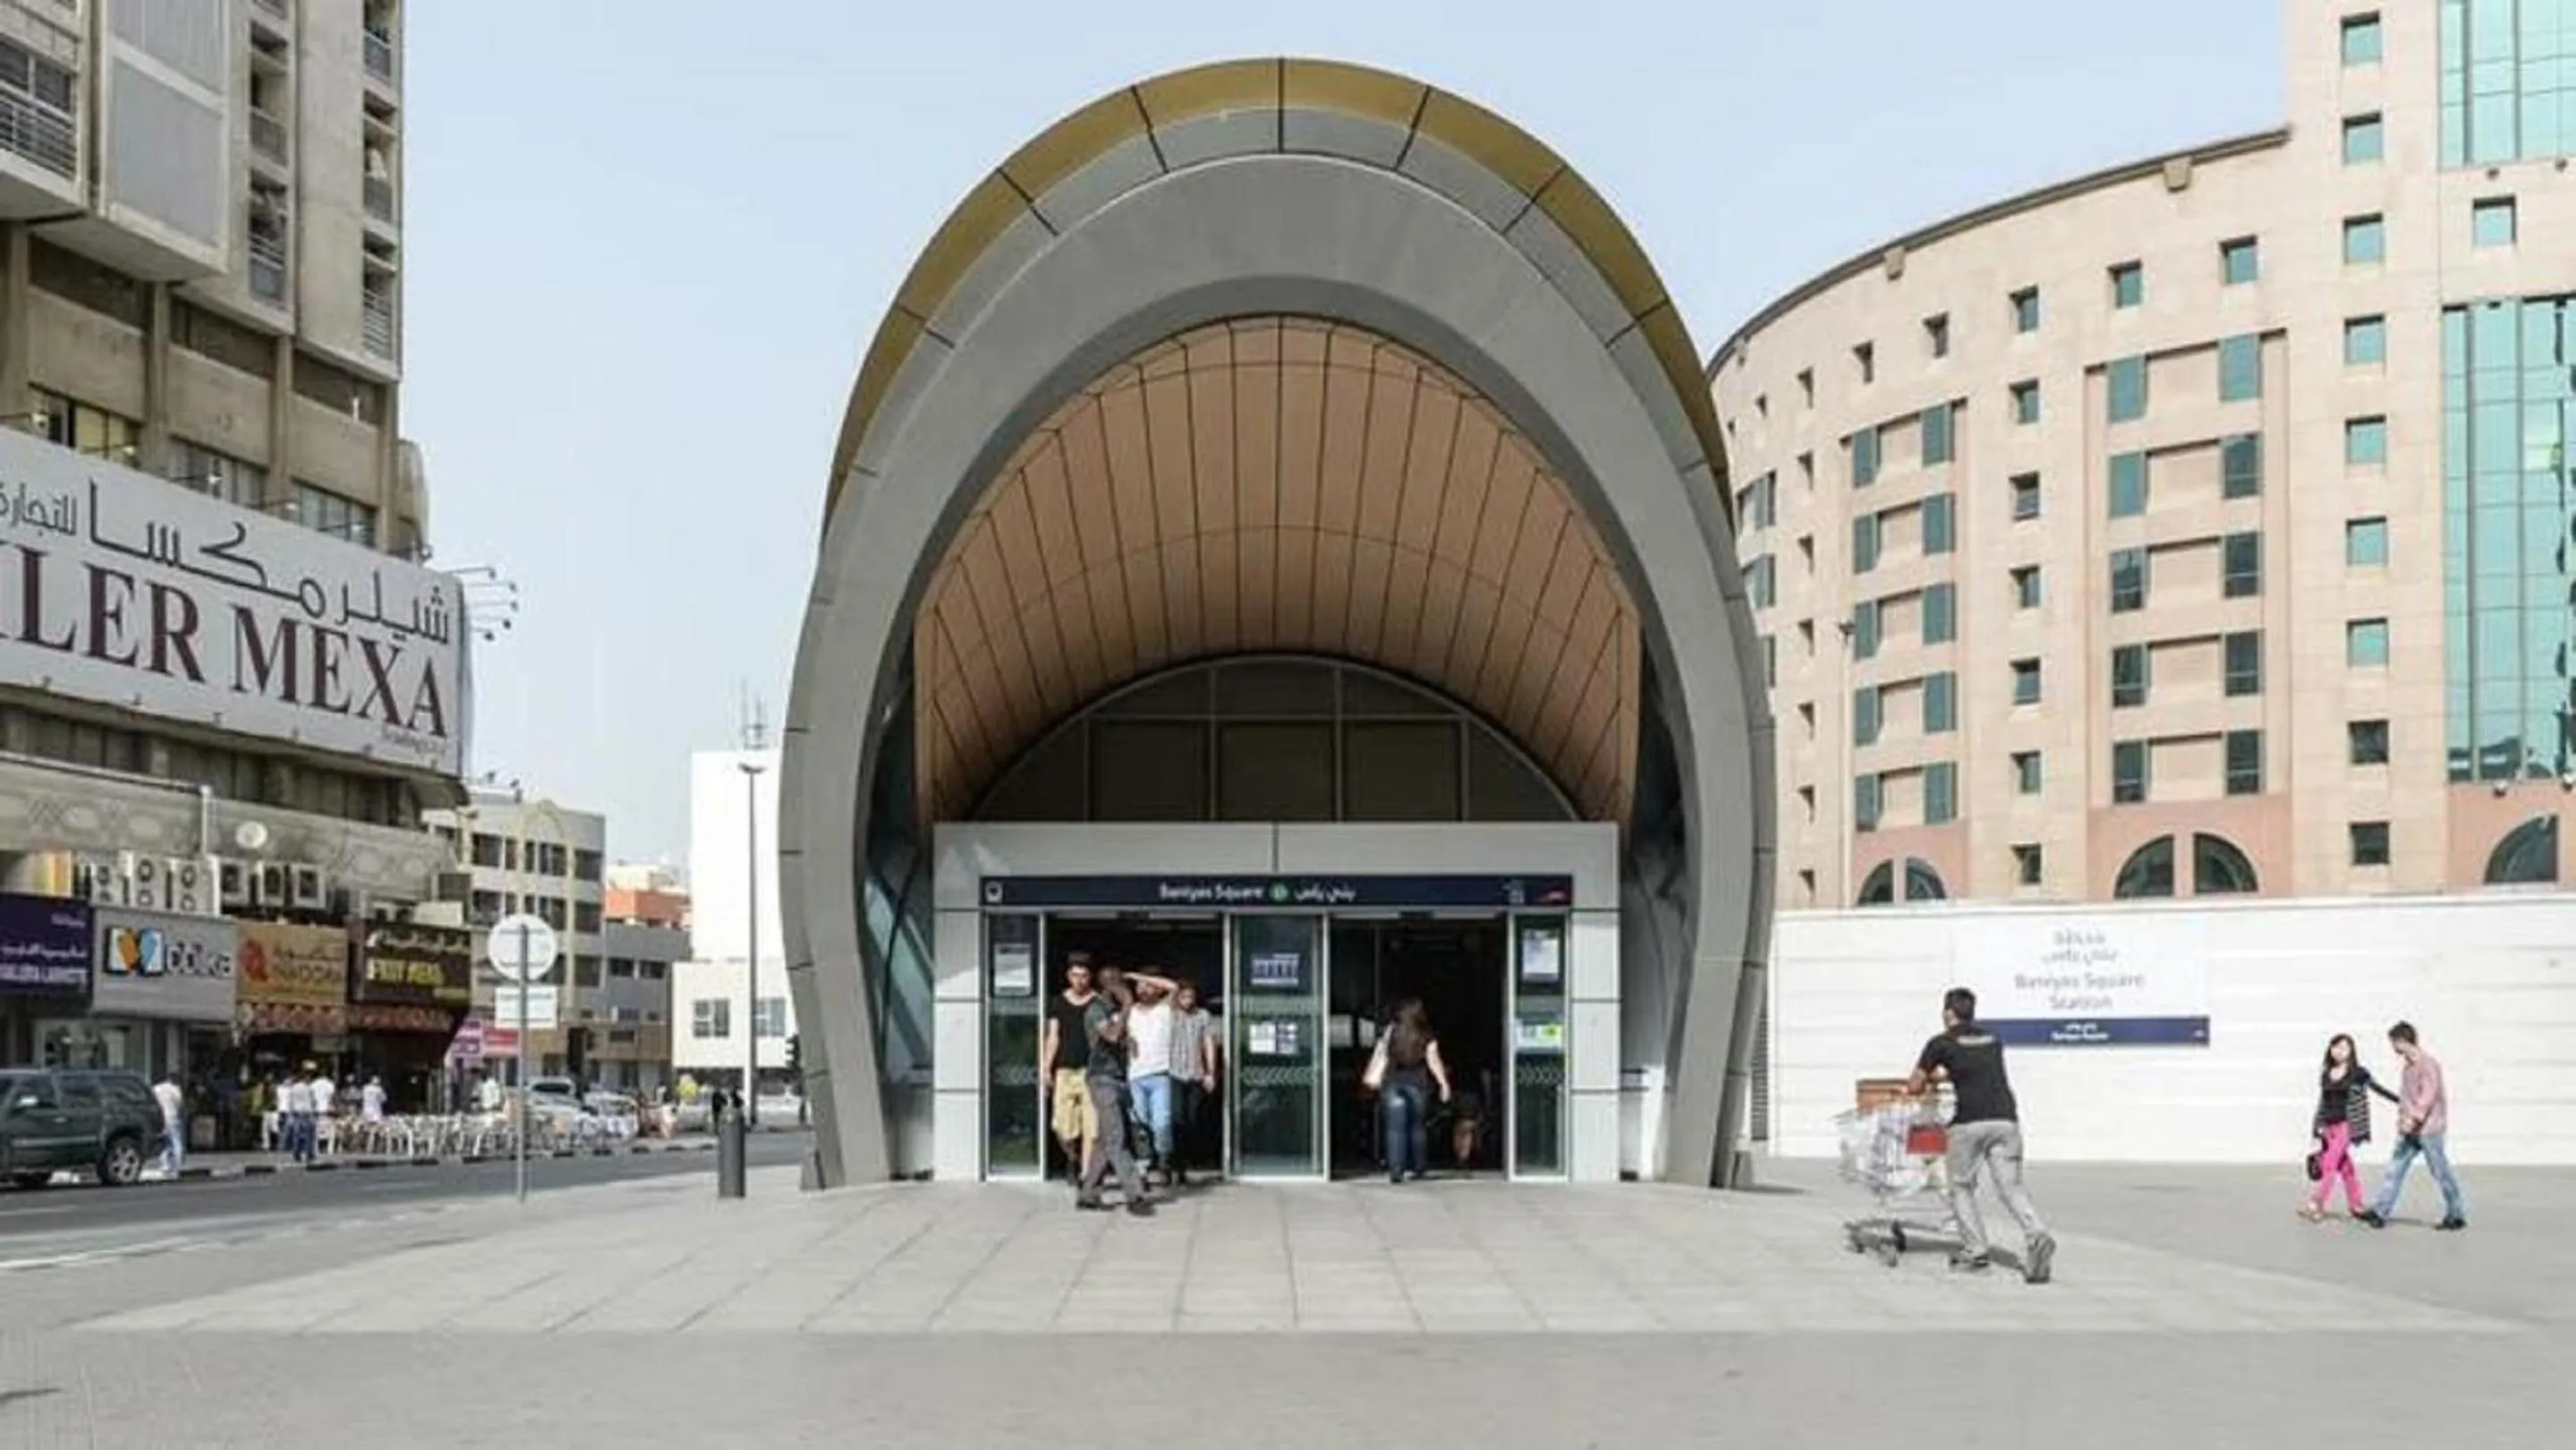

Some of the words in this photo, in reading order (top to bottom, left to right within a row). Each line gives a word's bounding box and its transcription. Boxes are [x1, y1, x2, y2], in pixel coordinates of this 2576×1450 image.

[89, 475, 326, 619] مكسا
[335, 568, 448, 646] شيلر
[0, 541, 206, 684] LER
[230, 603, 446, 739] MEXA
[1160, 881, 1212, 902] Baniyas
[1215, 882, 1264, 902] Square
[2014, 972, 2080, 990] Baniyas
[2084, 972, 2147, 990] Square
[2047, 994, 2113, 1011] Station
